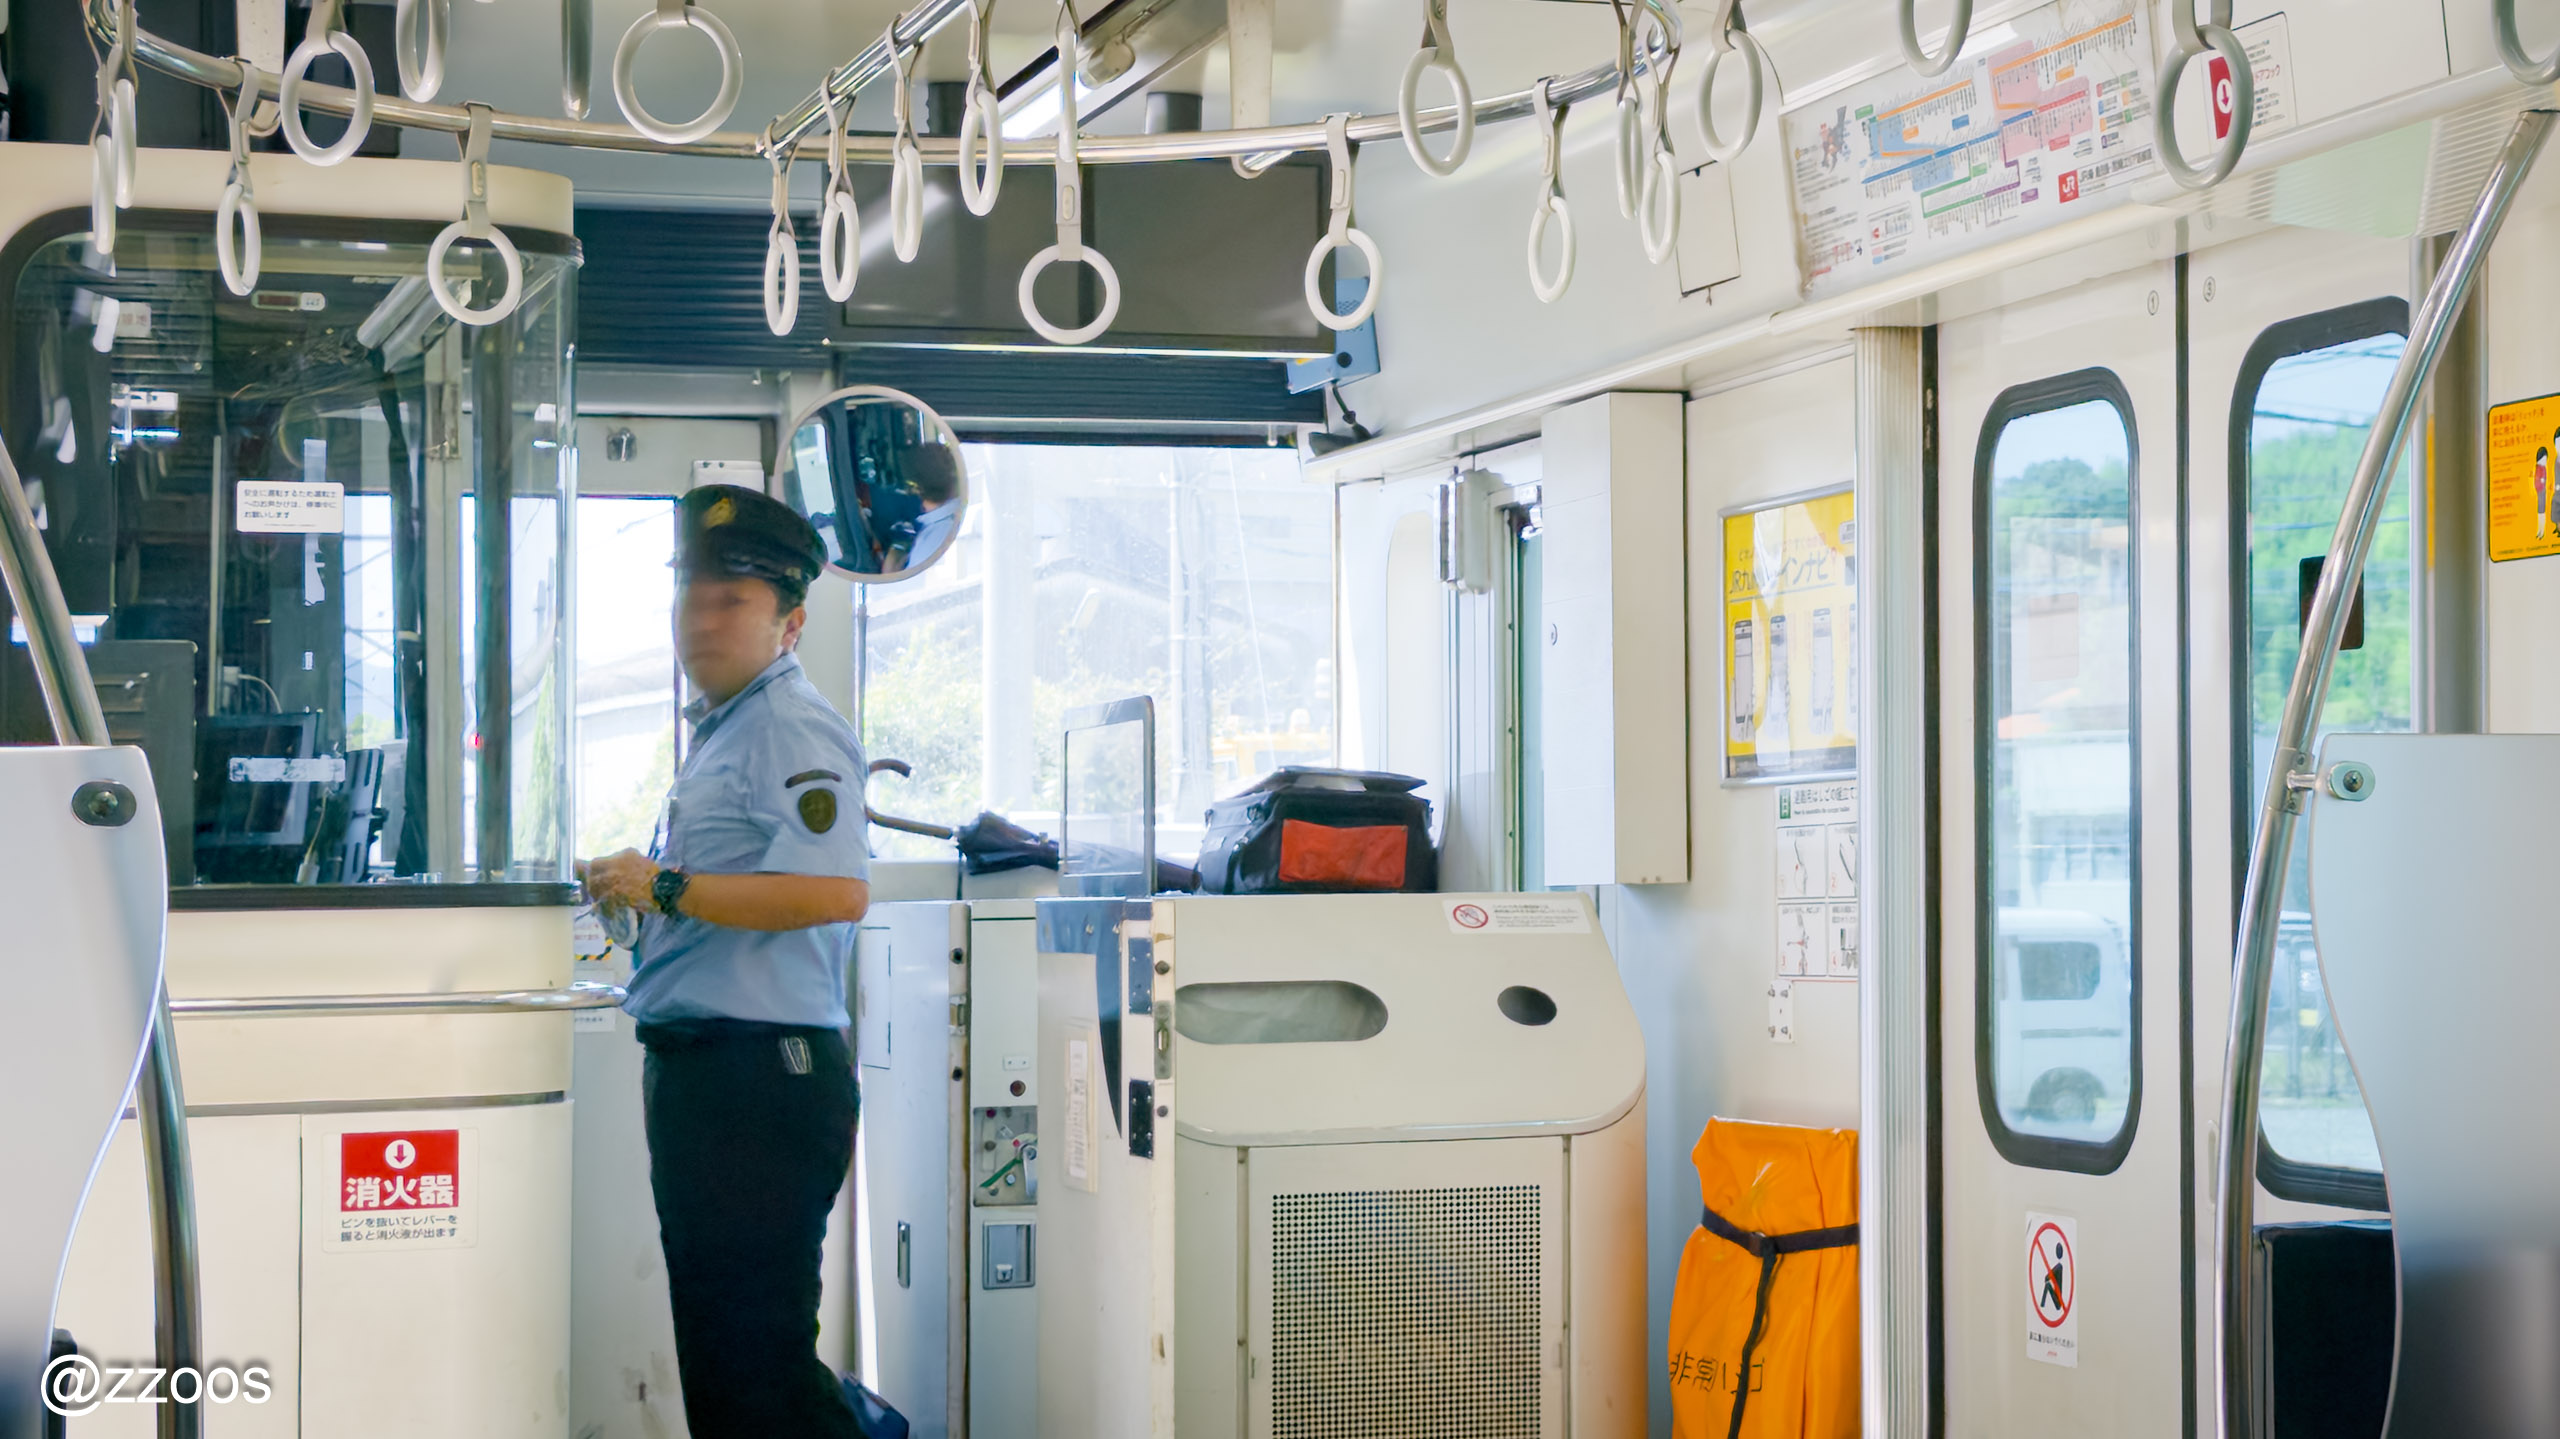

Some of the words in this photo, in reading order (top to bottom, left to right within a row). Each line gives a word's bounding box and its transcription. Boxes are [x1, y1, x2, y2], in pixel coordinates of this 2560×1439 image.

[346, 1174, 454, 1208] 消火器
[341, 1215, 457, 1229] ピンを抜いてレバーを
[341, 1227, 457, 1242] 握ると消火液が出ます
